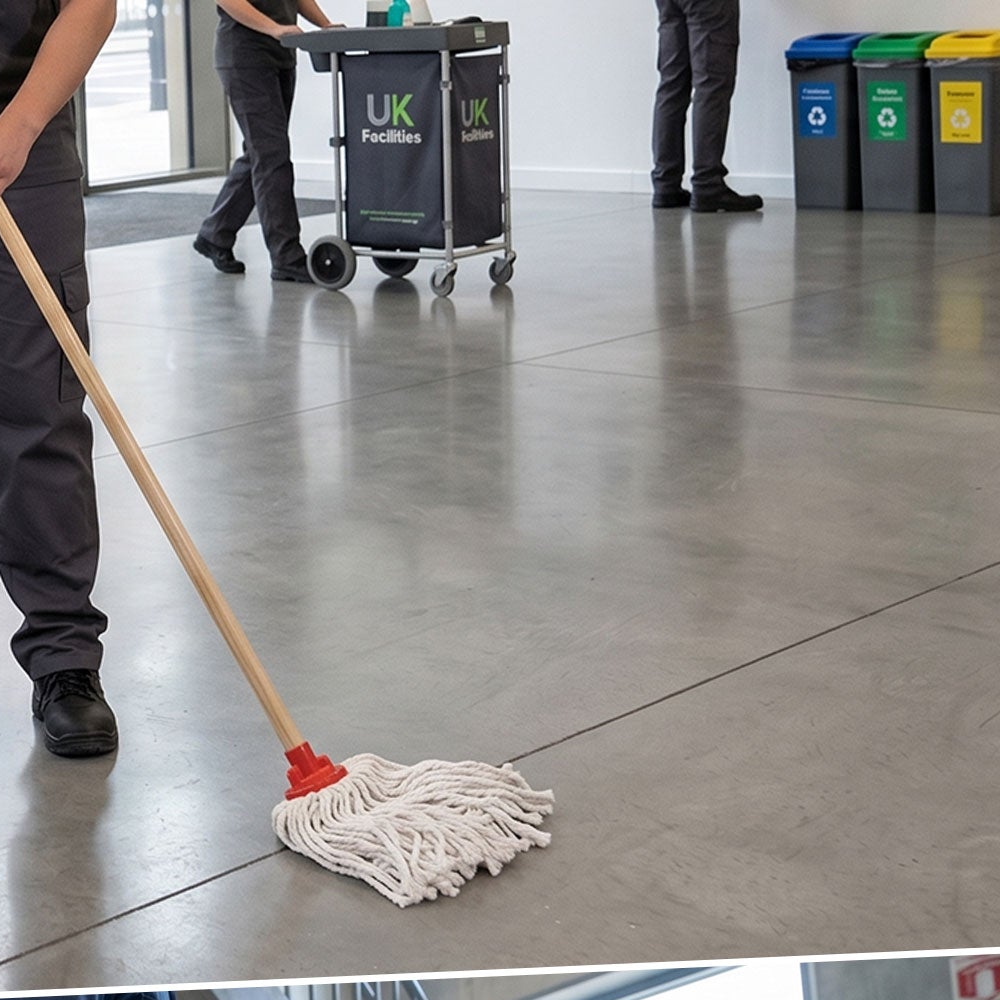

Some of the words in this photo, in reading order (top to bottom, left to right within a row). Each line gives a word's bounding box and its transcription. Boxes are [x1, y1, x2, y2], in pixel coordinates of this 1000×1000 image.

[366, 93, 415, 127] UK
[461, 97, 489, 127] UK
[361, 128, 422, 144] Facilities
